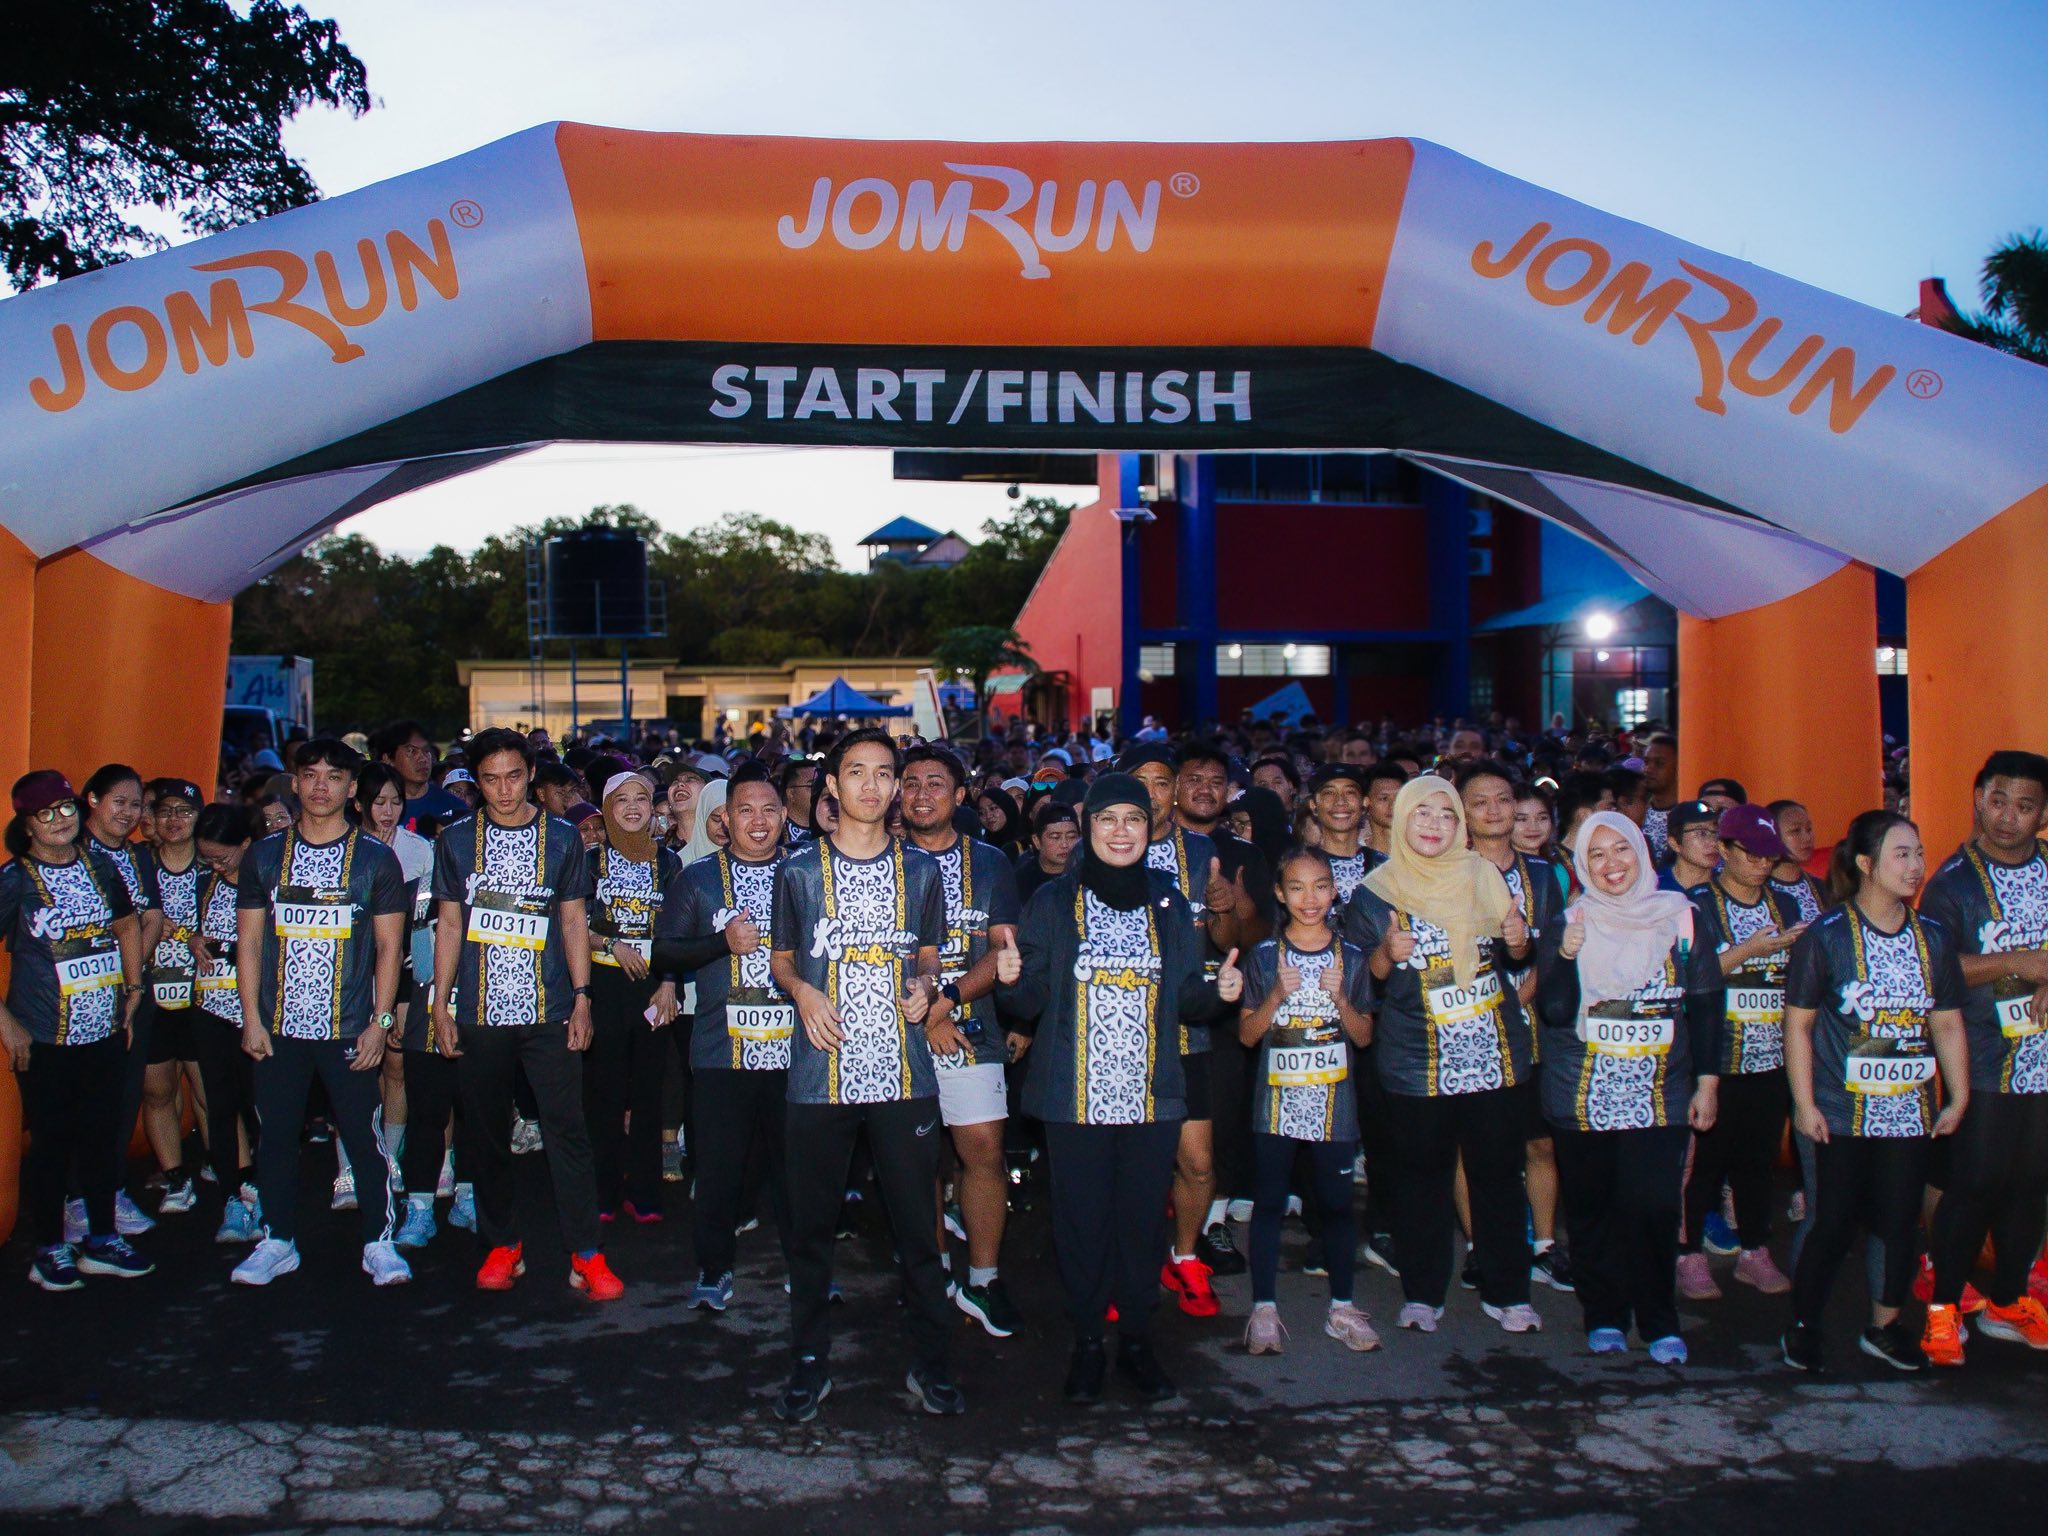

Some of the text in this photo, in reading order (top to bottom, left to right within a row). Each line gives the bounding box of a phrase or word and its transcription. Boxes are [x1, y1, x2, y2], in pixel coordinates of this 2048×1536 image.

[777, 161, 1161, 280] JOMRUN
[29, 218, 460, 412] JOMRUN
[1471, 221, 1897, 434] JOMRUN
[708, 363, 1252, 425] START/FINISH
[284, 907, 339, 926] 00721
[480, 912, 537, 936] 00311
[810, 918, 919, 960] Kaamatan
[843, 944, 894, 967] FunRun
[68, 956, 116, 980] 00312
[1093, 968, 1152, 991] FunRun
[158, 985, 188, 1000] 002
[1442, 976, 1498, 1009] 00940
[737, 1009, 793, 1027] 00991
[1598, 1023, 1663, 1043] 00939
[1277, 1048, 1339, 1071] 00784
[1859, 1062, 1925, 1081] 00602
